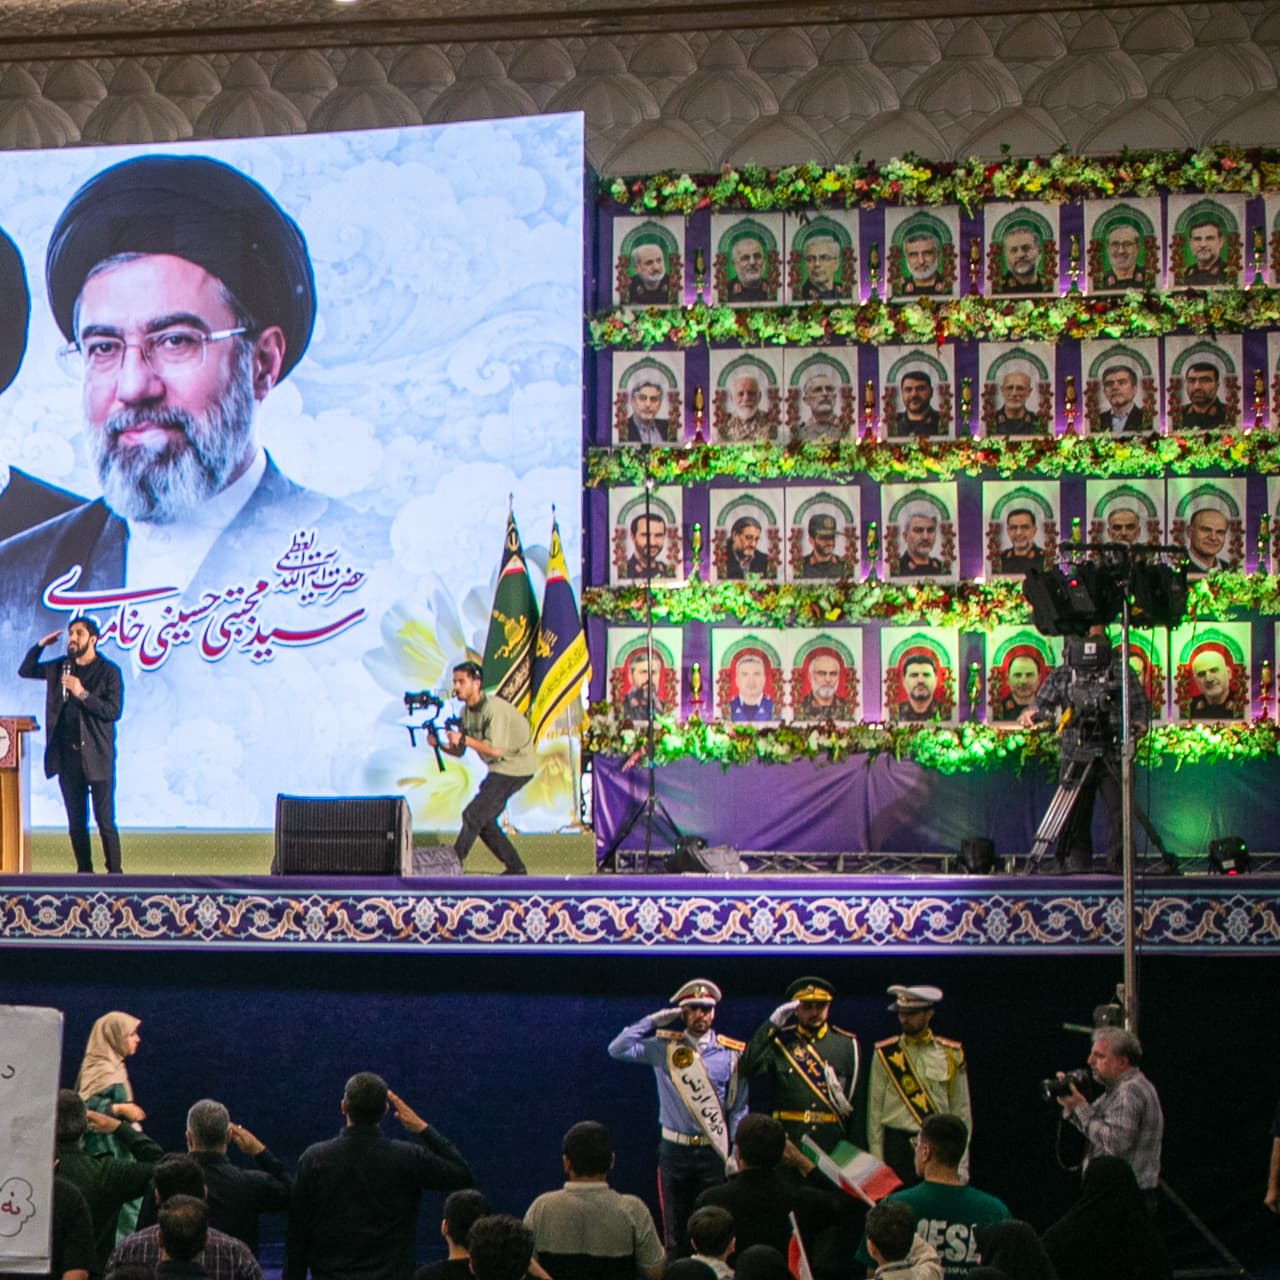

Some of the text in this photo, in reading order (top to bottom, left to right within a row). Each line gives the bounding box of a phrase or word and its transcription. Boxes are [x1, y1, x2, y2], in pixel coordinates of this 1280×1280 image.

[139, 592, 221, 666] حسینی
[203, 580, 269, 657] مجتبی
[243, 608, 366, 659] سید
[0, 1191, 22, 1216] نه
